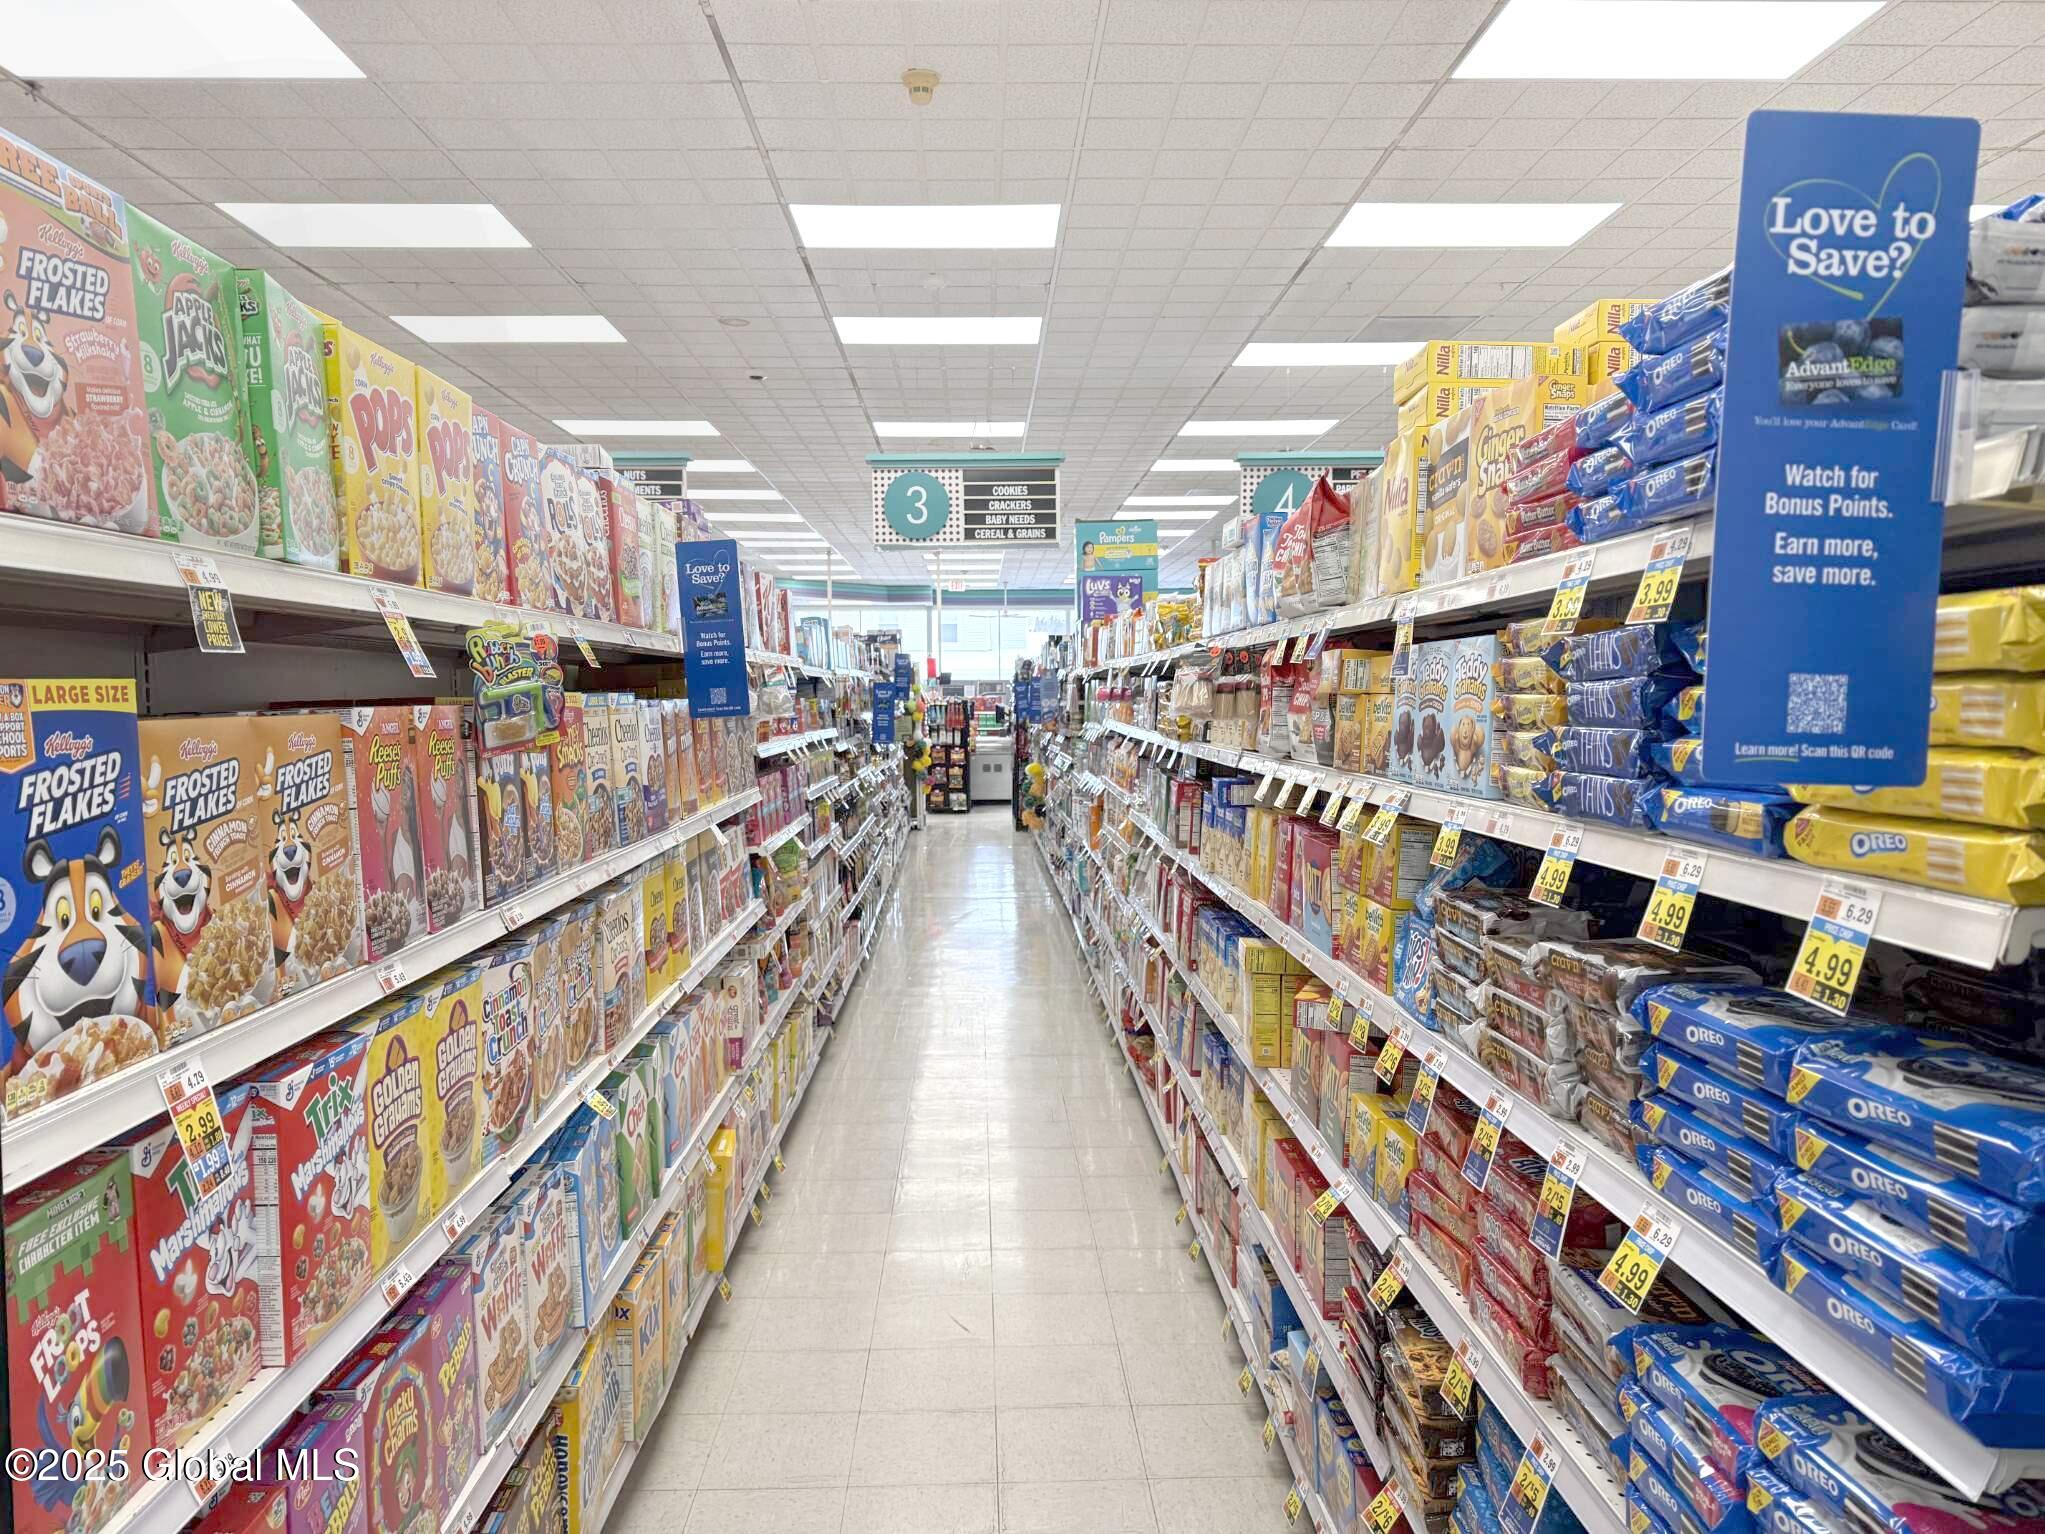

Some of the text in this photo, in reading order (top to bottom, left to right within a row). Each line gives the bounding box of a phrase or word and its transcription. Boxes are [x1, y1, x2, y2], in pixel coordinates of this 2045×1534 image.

[1769, 197, 1936, 239] Love to
[38, 223, 84, 258] Kellogg's
[18, 249, 109, 295] FROSTED
[1787, 238, 1913, 279] Save?
[28, 279, 106, 320] FLAKES
[174, 292, 213, 326] APPLE
[1607, 304, 1621, 335] Nilla
[162, 310, 227, 394] JACKS
[1436, 345, 1450, 376] Nilla
[1785, 356, 1897, 378] AdvantEdge
[1653, 352, 1683, 384] OREO
[1550, 381, 1575, 393] Ginger
[1550, 389, 1575, 400] Snaps
[1437, 387, 1451, 418] Nilla
[349, 386, 414, 475] POPS
[1646, 408, 1677, 438] OREO
[1476, 424, 1526, 468] Ginger
[505, 451, 540, 485] CRUNCH
[623, 470, 646, 480] NUTS
[1785, 464, 1878, 488] Watch for
[992, 486, 1028, 496] COOKIES
[1646, 470, 1676, 497] OREO
[906, 486, 928, 524] 3
[988, 500, 1032, 510] CRACKERS
[1274, 482, 1296, 518] 4
[1764, 492, 1894, 518] Bonus Points.
[974, 528, 1046, 539] CEREAL & GRAINS
[985, 515, 1036, 524] BABY NEEDS
[1099, 532, 1135, 544] Pampers
[1774, 532, 1879, 560] Earn more,
[686, 562, 730, 575] Love to
[691, 573, 726, 585] Save?
[1772, 565, 1877, 586] save more.
[198, 590, 223, 611] NEW
[1086, 579, 1111, 595] Luvs
[1640, 579, 1674, 605] 3.99
[204, 620, 228, 634] LOWER
[206, 633, 233, 648] PRICE!
[1588, 632, 1623, 670] THINS
[1420, 655, 1449, 684] Teddy
[1455, 652, 1488, 684] Teddy
[32, 685, 129, 704] LARGE SIZE
[1584, 683, 1616, 718] THINS
[44, 731, 93, 760] Kellogg's
[180, 737, 218, 762] Kellogg's
[288, 732, 316, 751] Kellogg's
[369, 734, 401, 766] Reese's
[428, 730, 455, 757] Reese's
[1579, 730, 1613, 768] THINS
[1735, 742, 1894, 759] Learn more! Scan this QR code
[18, 751, 121, 809] FROSTED
[164, 758, 240, 807] FROSTED
[276, 752, 332, 792] FROSTED
[376, 762, 401, 792] Puffs
[172, 784, 237, 832] FLAKES
[283, 774, 330, 812] FLAKES
[1578, 776, 1614, 817] THINS
[1673, 796, 1713, 814] OREO
[28, 782, 115, 838] FLAKES
[307, 804, 339, 830] CINNAMON
[206, 820, 247, 850] CINNAMON
[1852, 834, 1907, 856] OREO
[1540, 867, 1567, 890] 4.99
[1682, 862, 1702, 878] 6.29
[1651, 899, 1686, 929] 4.99
[1846, 904, 1873, 925] 6.29
[1663, 934, 1680, 947] 1.30
[1804, 946, 1853, 987] 4.99
[482, 972, 528, 1021] Cinnamon
[1823, 989, 1847, 1010] 1.30
[493, 1003, 522, 1034] Toast
[487, 1011, 528, 1066] Crunch
[1685, 1025, 1724, 1046] OREO
[304, 1072, 355, 1143] Trix
[1693, 1082, 1730, 1104] OREO
[185, 1111, 215, 1143] 2.99
[627, 1096, 647, 1138] Chex
[1848, 1098, 1911, 1127] OREO
[1680, 1129, 1715, 1151] OREO
[199, 1150, 220, 1178] 1.99
[1565, 1158, 1580, 1175] 2.99
[1851, 1168, 1908, 1199] OREO
[1686, 1188, 1721, 1214] OREO
[75, 1211, 100, 1237] ITEM
[1652, 1229, 1673, 1249] 6.29
[1829, 1233, 1883, 1267] OREO
[1614, 1253, 1649, 1291] 4.99
[1620, 1292, 1637, 1308] 1.30
[1827, 1297, 1875, 1334] OREO
[29, 1288, 92, 1384] FROOT
[43, 1320, 101, 1403] LOOPS
[1653, 1372, 1684, 1399] OREO
[386, 1386, 414, 1433] Lucky
[384, 1408, 418, 1466] Charms
[1639, 1418, 1667, 1451] OREO
[1795, 1453, 1840, 1498] OREO
[1648, 1476, 1678, 1513] OREO
